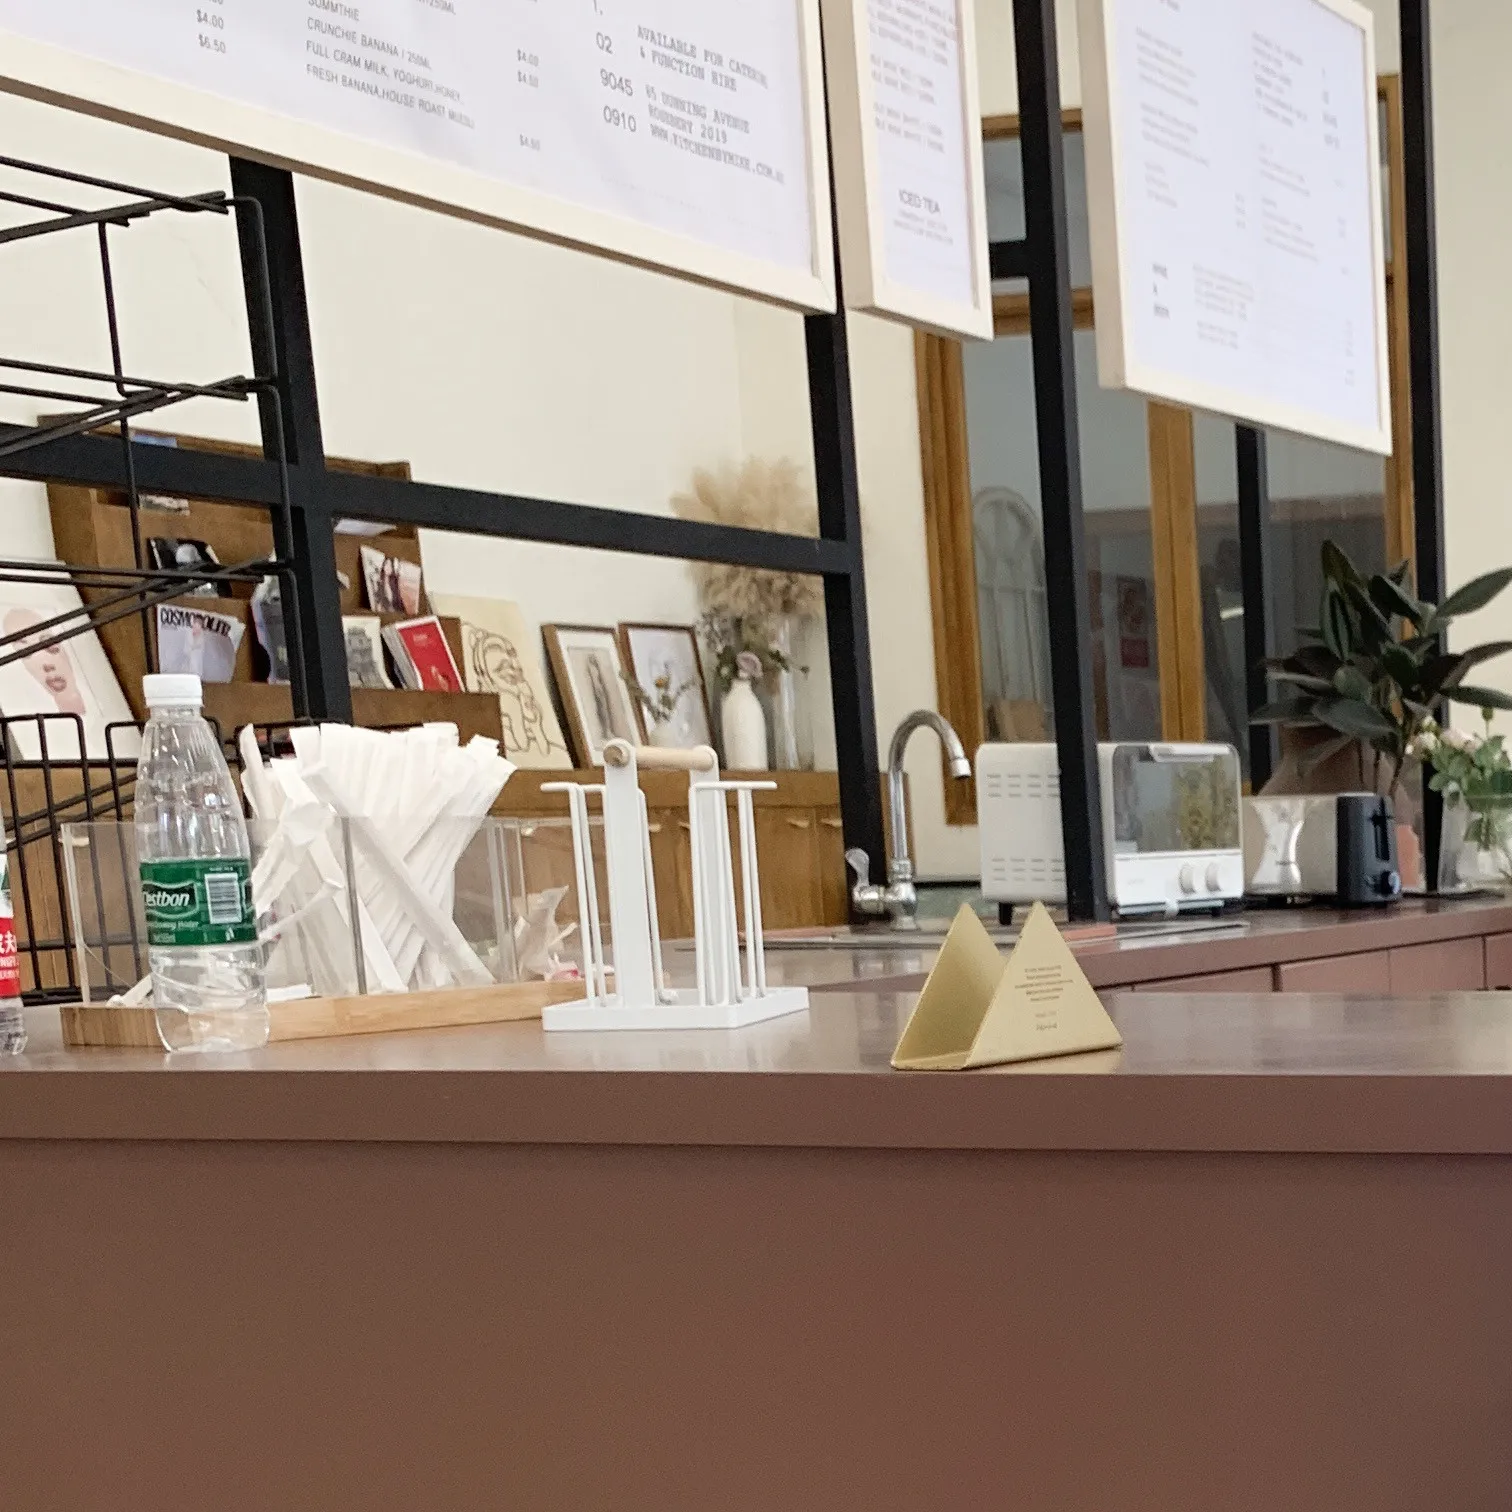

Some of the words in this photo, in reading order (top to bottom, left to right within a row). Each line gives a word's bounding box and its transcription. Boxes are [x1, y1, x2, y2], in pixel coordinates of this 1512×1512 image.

[306, 40, 331, 60] FULL
[307, 16, 357, 45] CRUNCHIE
[361, 33, 399, 58] BANANA
[596, 31, 613, 55] 02
[637, 24, 697, 59] AVAILABLE
[703, 48, 723, 68] FOR
[306, 63, 338, 85] FRESH
[651, 49, 705, 81] FUNCTION
[600, 68, 633, 97] 9045
[603, 105, 637, 133] 0910
